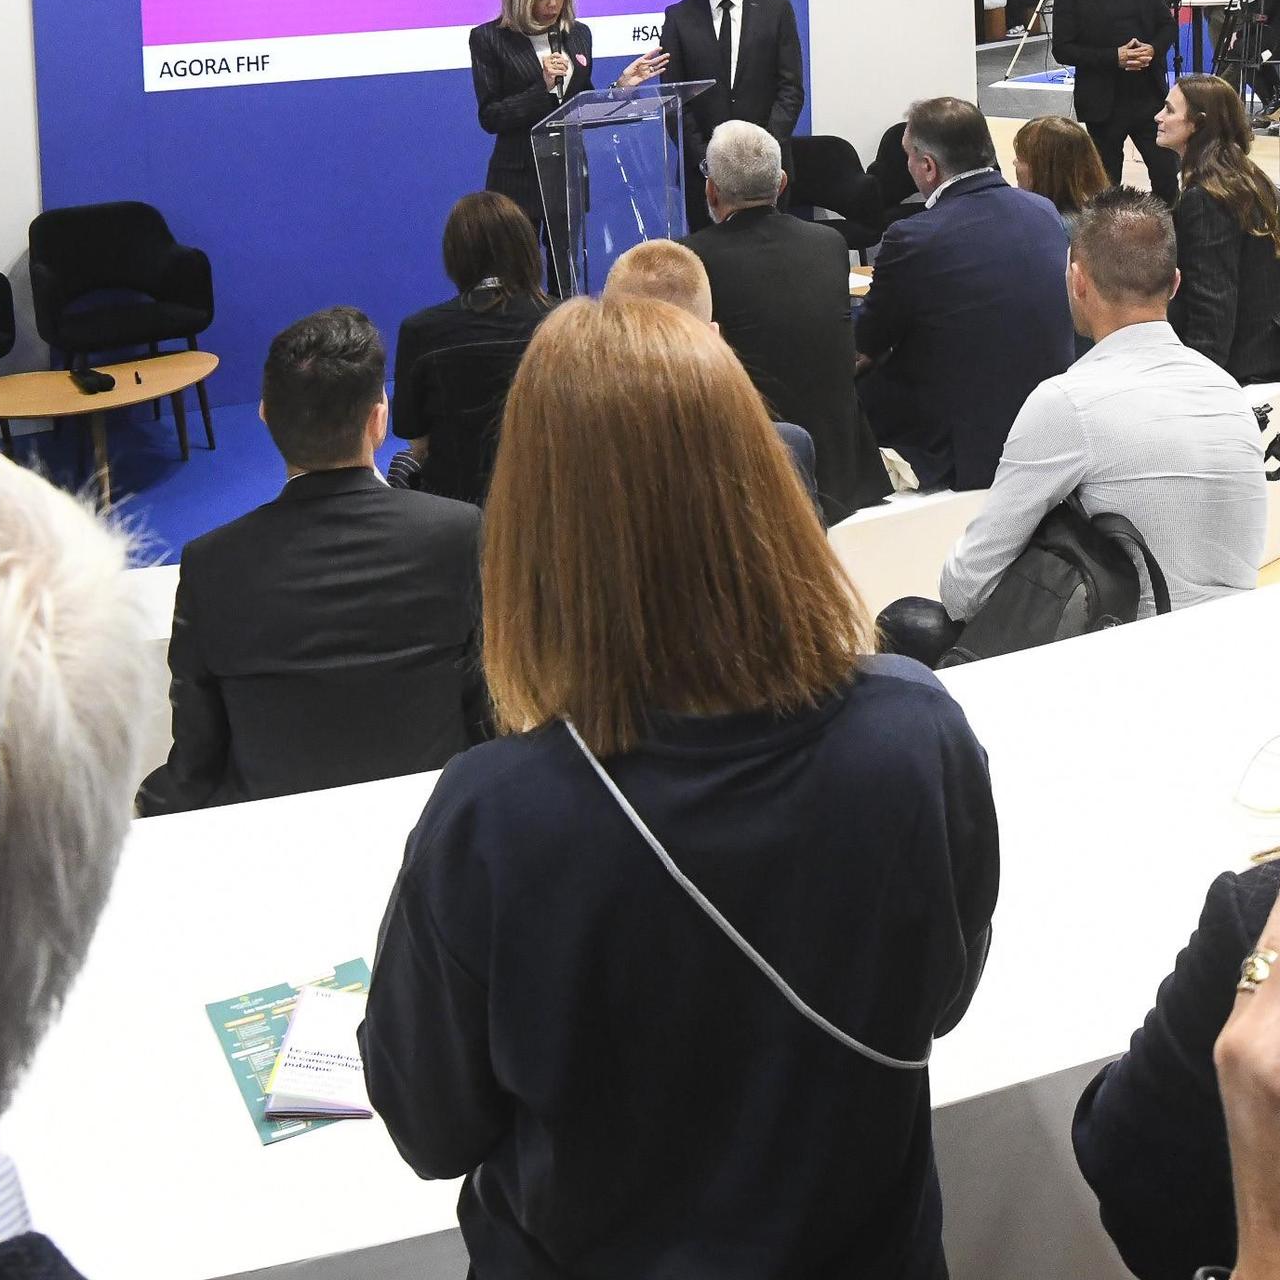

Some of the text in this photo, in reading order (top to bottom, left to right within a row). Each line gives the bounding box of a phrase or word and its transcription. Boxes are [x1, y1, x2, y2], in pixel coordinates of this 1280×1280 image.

[632, 25, 662, 42] #SA
[158, 53, 271, 80] AGORA FHF
